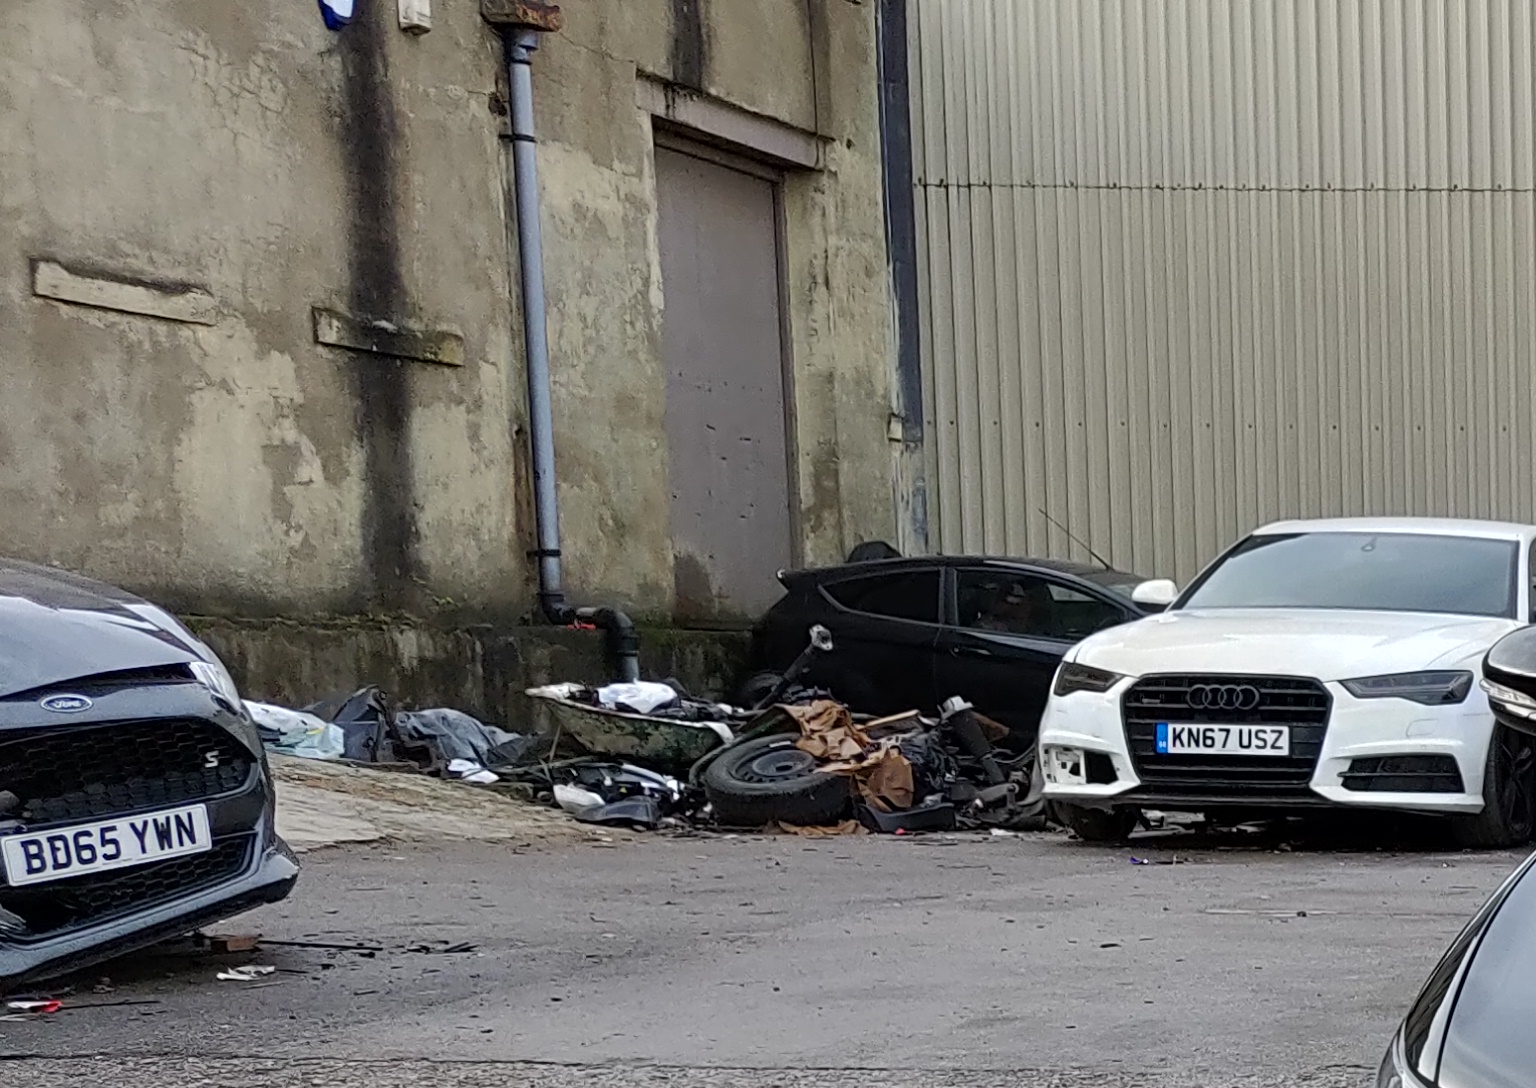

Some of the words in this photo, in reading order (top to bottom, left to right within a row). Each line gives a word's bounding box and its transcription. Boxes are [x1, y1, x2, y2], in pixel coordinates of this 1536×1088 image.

[1172, 727, 1231, 749] KN67
[1238, 728, 1284, 750] USZ
[20, 825, 121, 875] BD65
[129, 812, 197, 854] YWN
